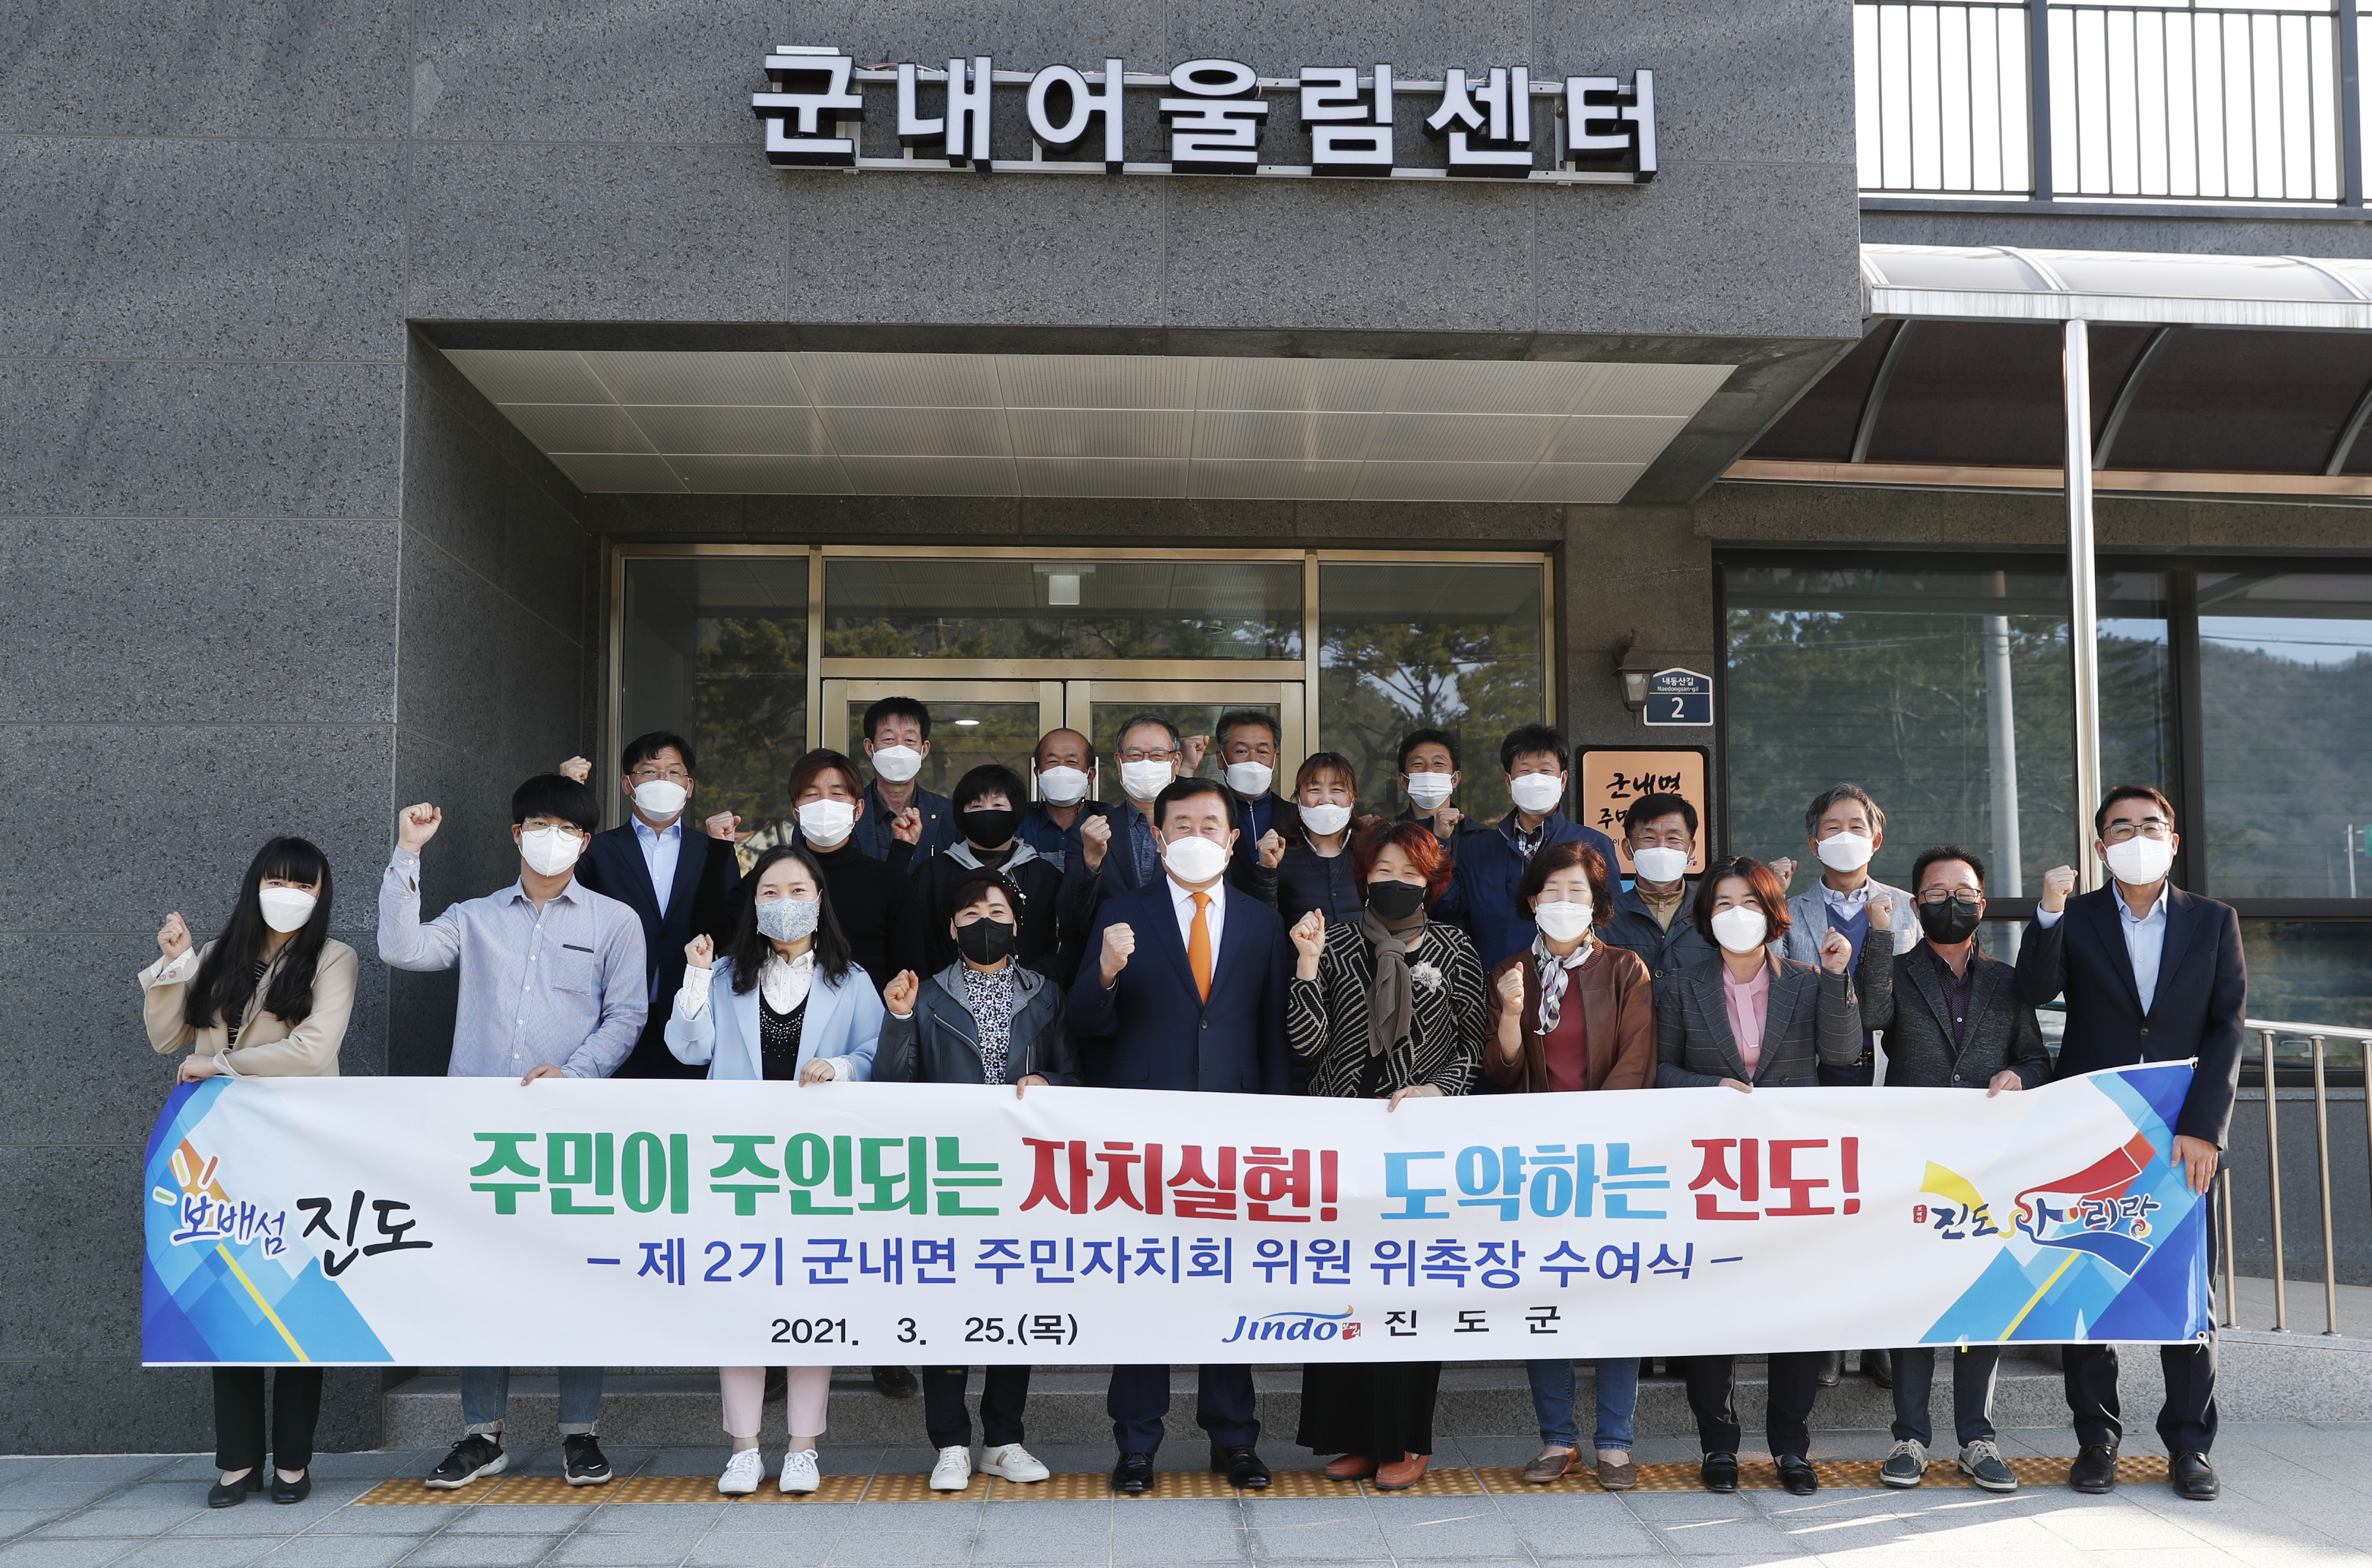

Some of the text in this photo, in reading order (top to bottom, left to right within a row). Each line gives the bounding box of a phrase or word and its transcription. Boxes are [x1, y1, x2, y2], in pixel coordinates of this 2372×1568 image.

[752, 54, 1658, 183] 군내어울림센터
[1661, 677, 1694, 686] 내동산길
[1671, 697, 1684, 718] 2
[471, 1132, 1860, 1222] 주민이 주인되는 자치실현! 도약하는 진도!
[173, 1189, 433, 1277] 보배섬 진도
[1930, 1203, 1999, 1240] 진도
[638, 1238, 685, 1285] 제
[704, 1238, 782, 1285] 2기
[803, 1238, 955, 1284] 군내면
[975, 1237, 1231, 1284] 주민자치회
[1253, 1240, 1350, 1284] 위원
[1371, 1239, 1525, 1288] 위촉장
[1540, 1241, 1693, 1287] 수여식
[772, 1319, 858, 1345] 2021.
[898, 1318, 925, 1344] 3.
[1221, 1314, 1338, 1343] Jindo
